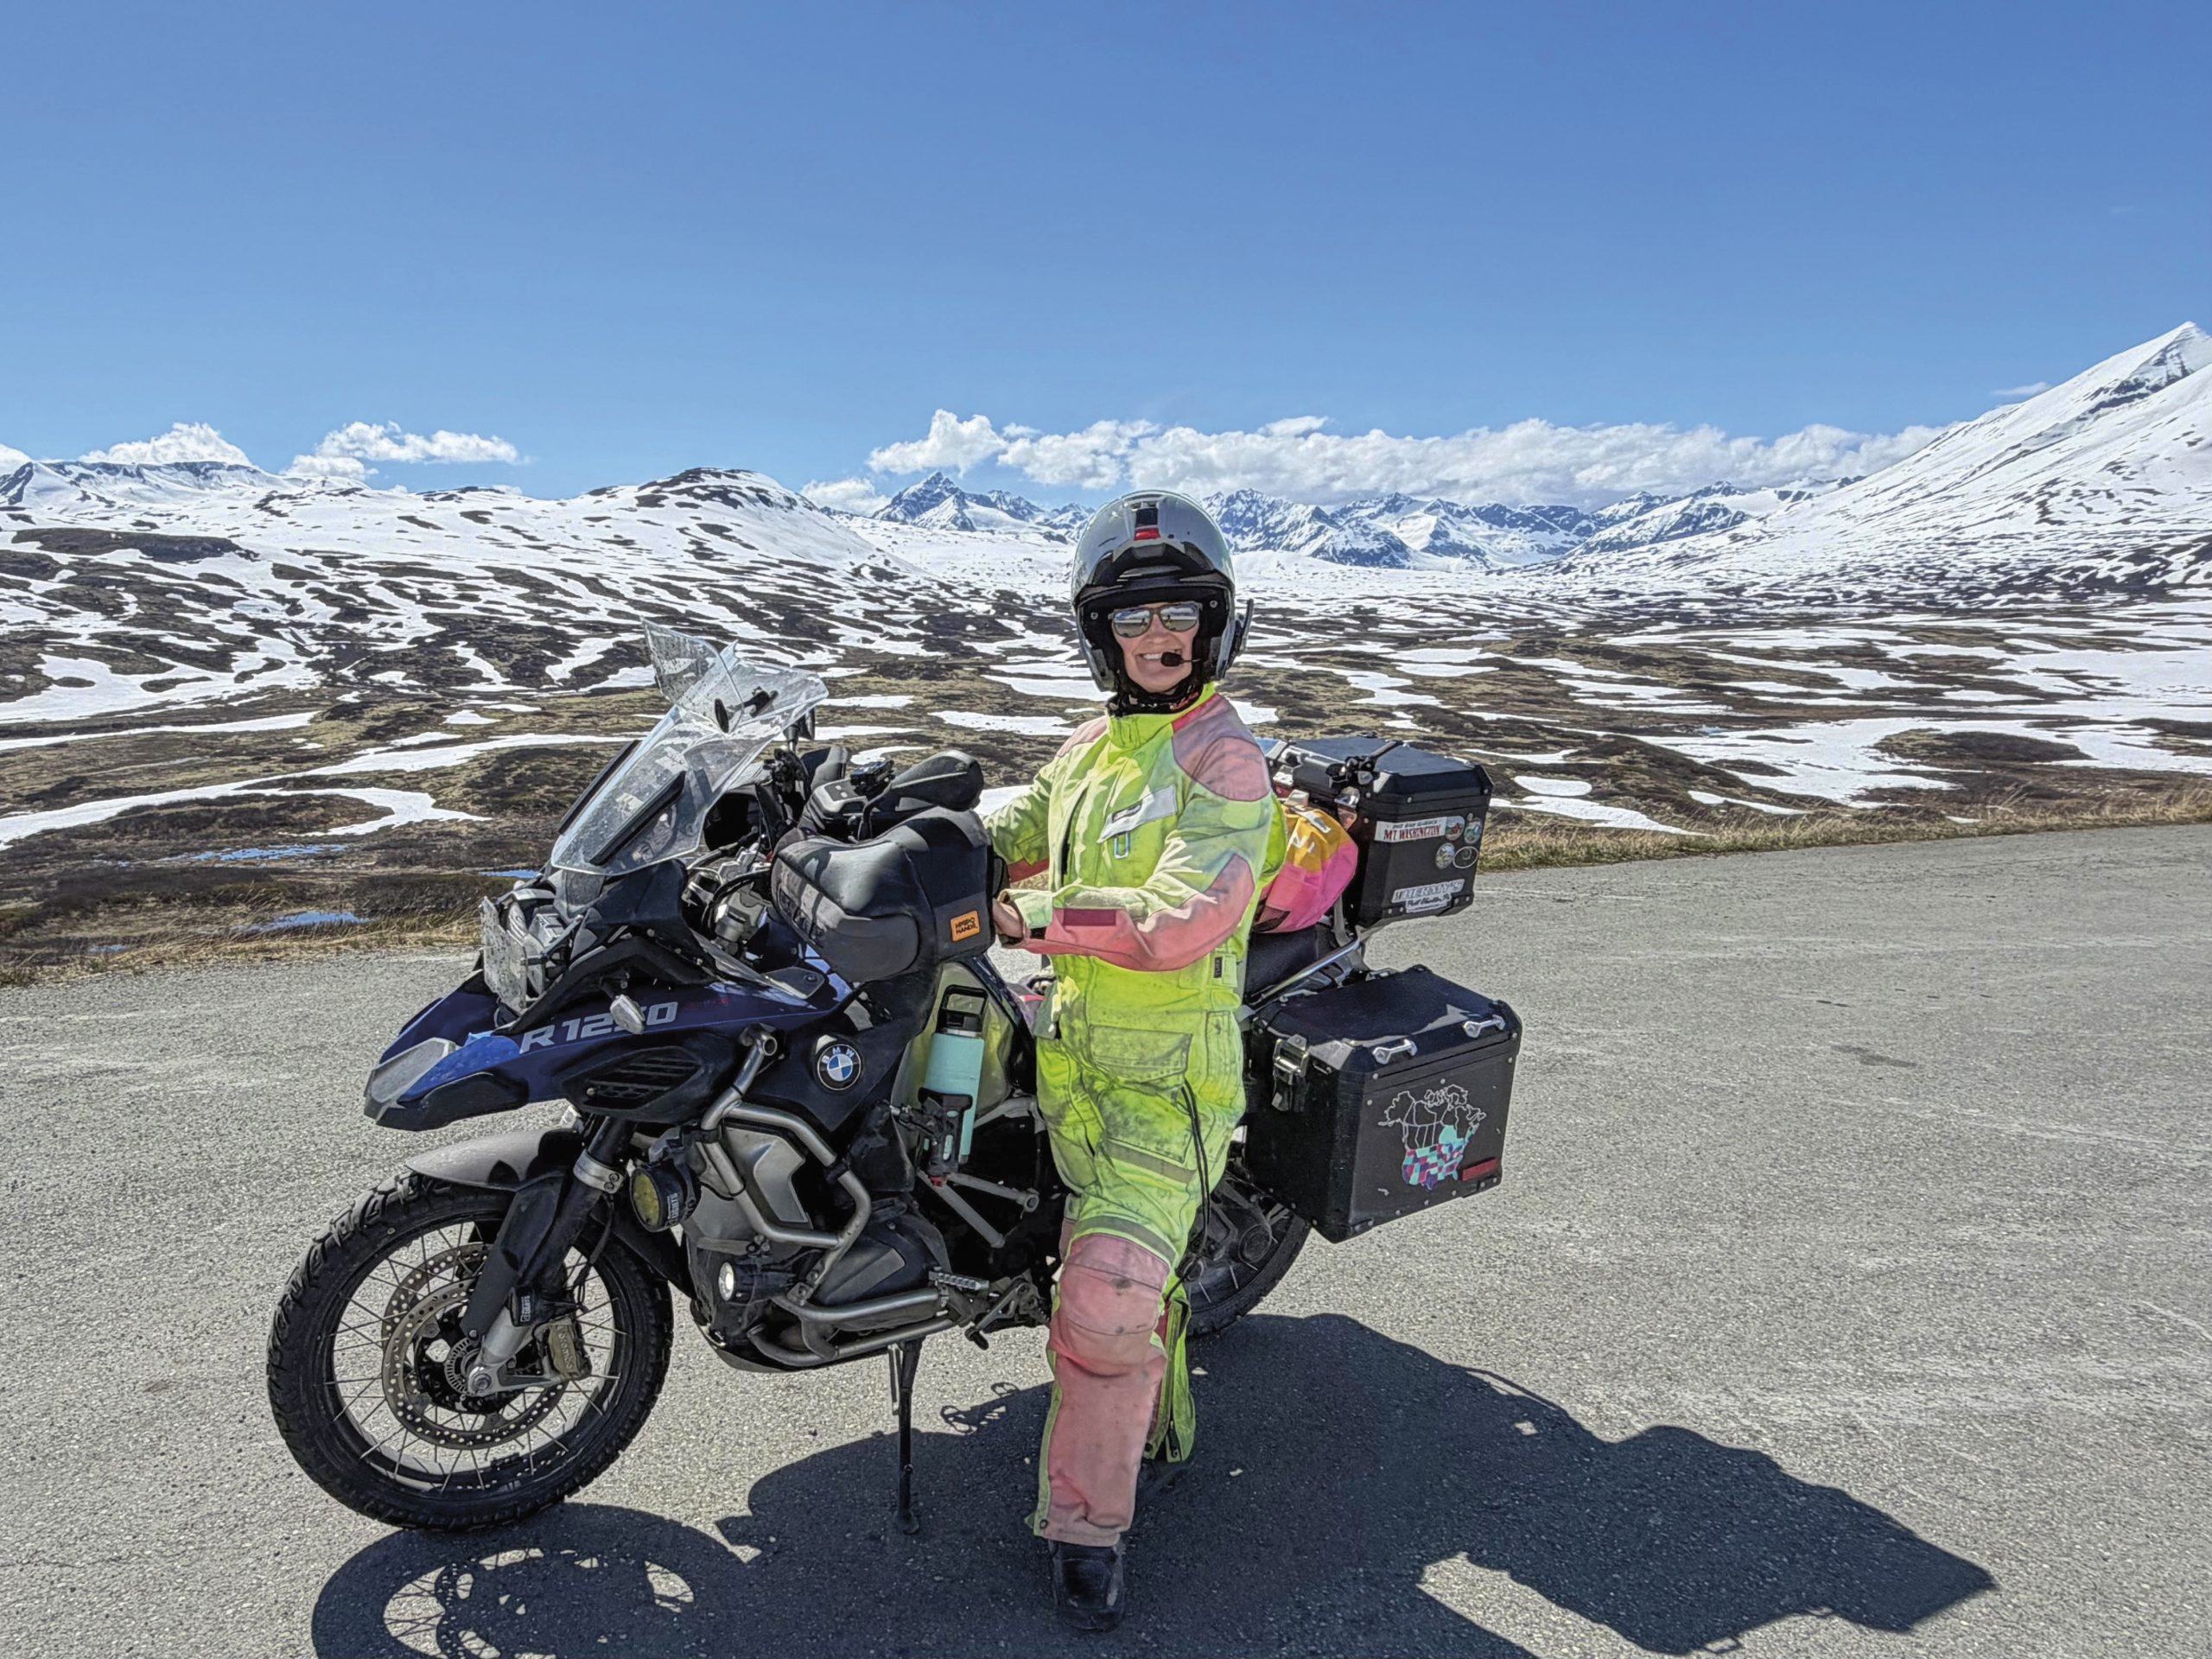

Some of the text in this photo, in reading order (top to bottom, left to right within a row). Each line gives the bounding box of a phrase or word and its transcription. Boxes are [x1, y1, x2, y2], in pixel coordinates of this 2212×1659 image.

[518, 1001, 678, 1054] R 120
[821, 1046, 855, 1064] BMW
